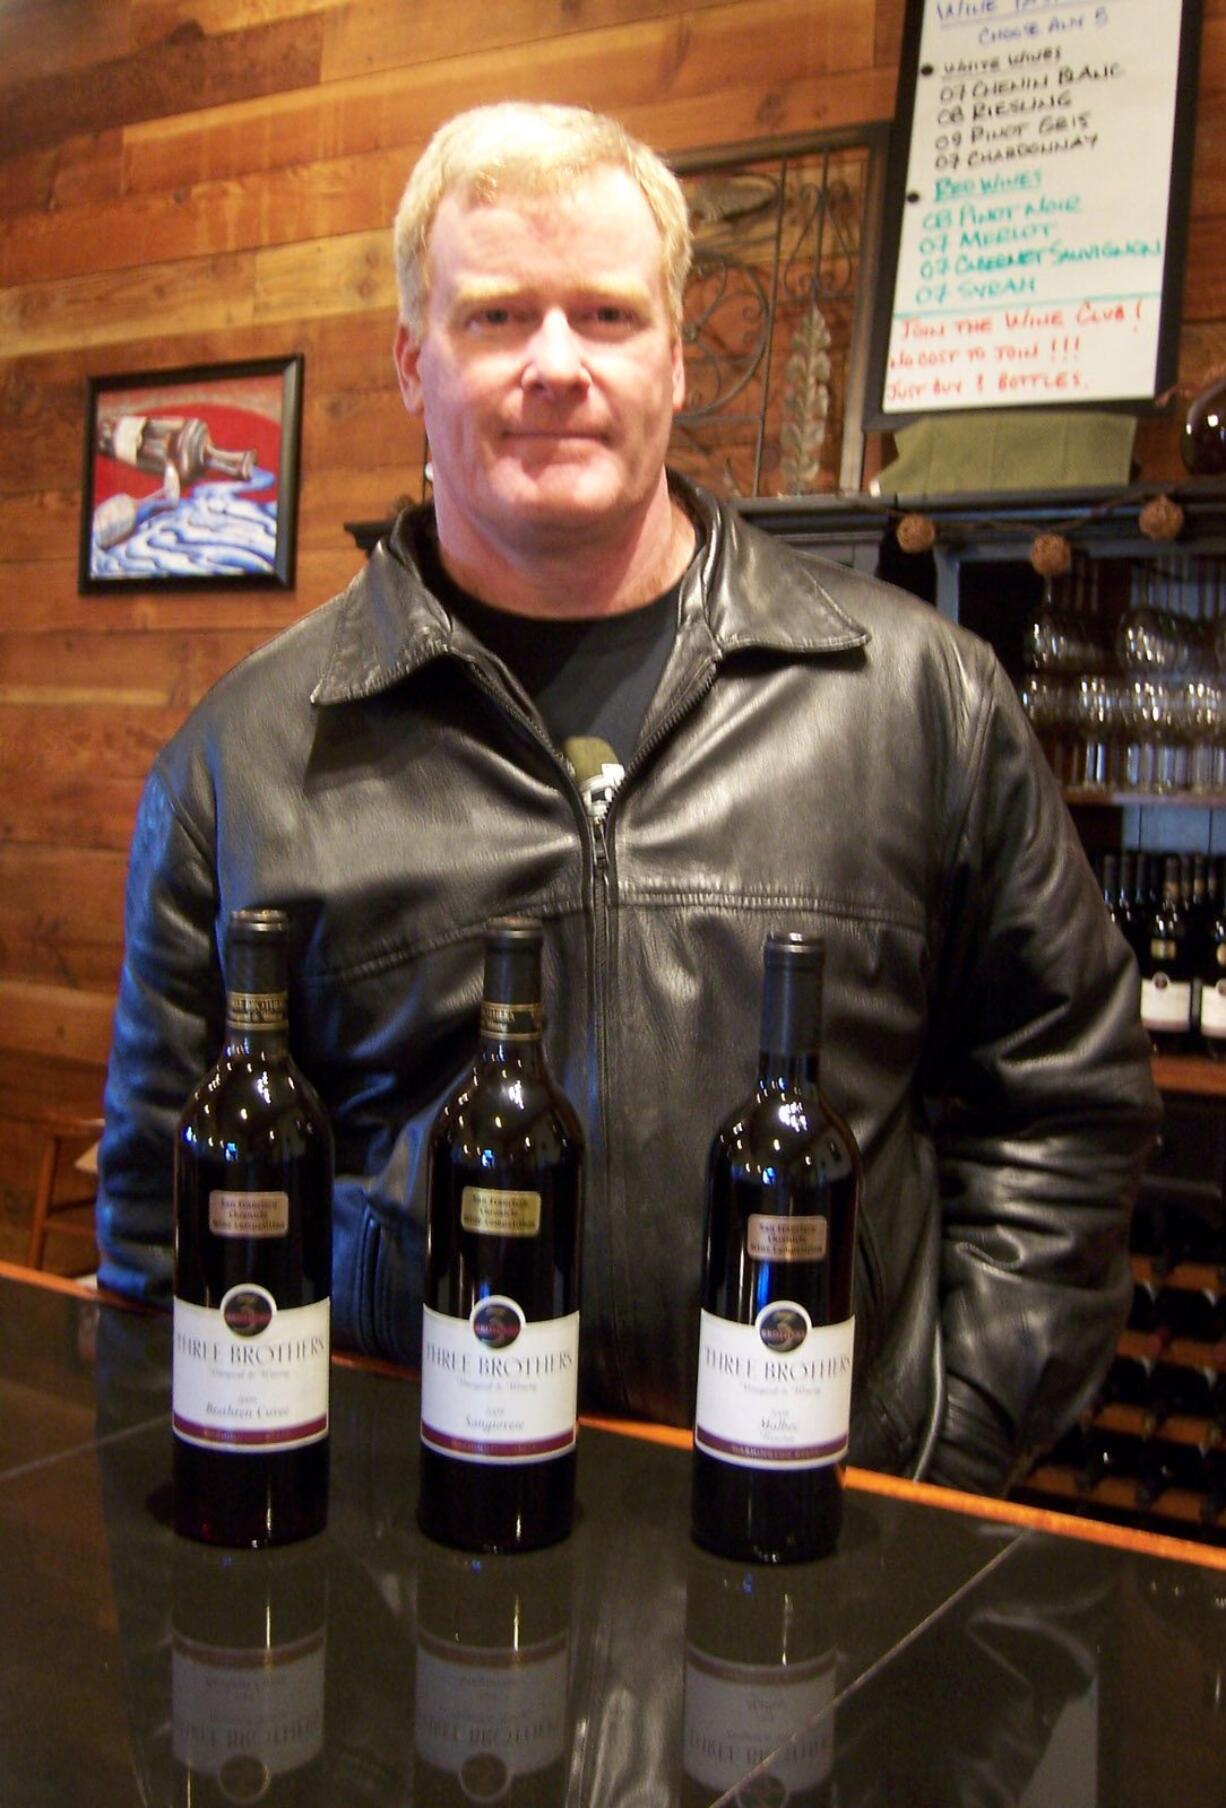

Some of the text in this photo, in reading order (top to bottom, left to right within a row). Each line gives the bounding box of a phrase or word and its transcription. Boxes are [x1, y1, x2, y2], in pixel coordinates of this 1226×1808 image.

[971, 75, 1049, 98] CHENIN
[1058, 63, 1124, 85] BLANC
[972, 90, 1072, 121] RIESLING
[971, 121, 1030, 145] PINOT
[1037, 109, 1092, 136] GRIS
[967, 132, 1099, 167] CHARDONNAY
[959, 203, 1023, 228] PINOT
[1024, 194, 1081, 216] NOIR
[960, 222, 1055, 248] MERLOT
[957, 276, 1036, 300] SYRAH
[952, 318, 993, 336] THE
[1004, 306, 1064, 331] WINE
[995, 342, 1040, 361] JOIN
[175, 1332, 325, 1365] THREE BROTHERS
[426, 1342, 574, 1378] THREE BROTHERS
[705, 1345, 851, 1382] THREE BROTHERS
